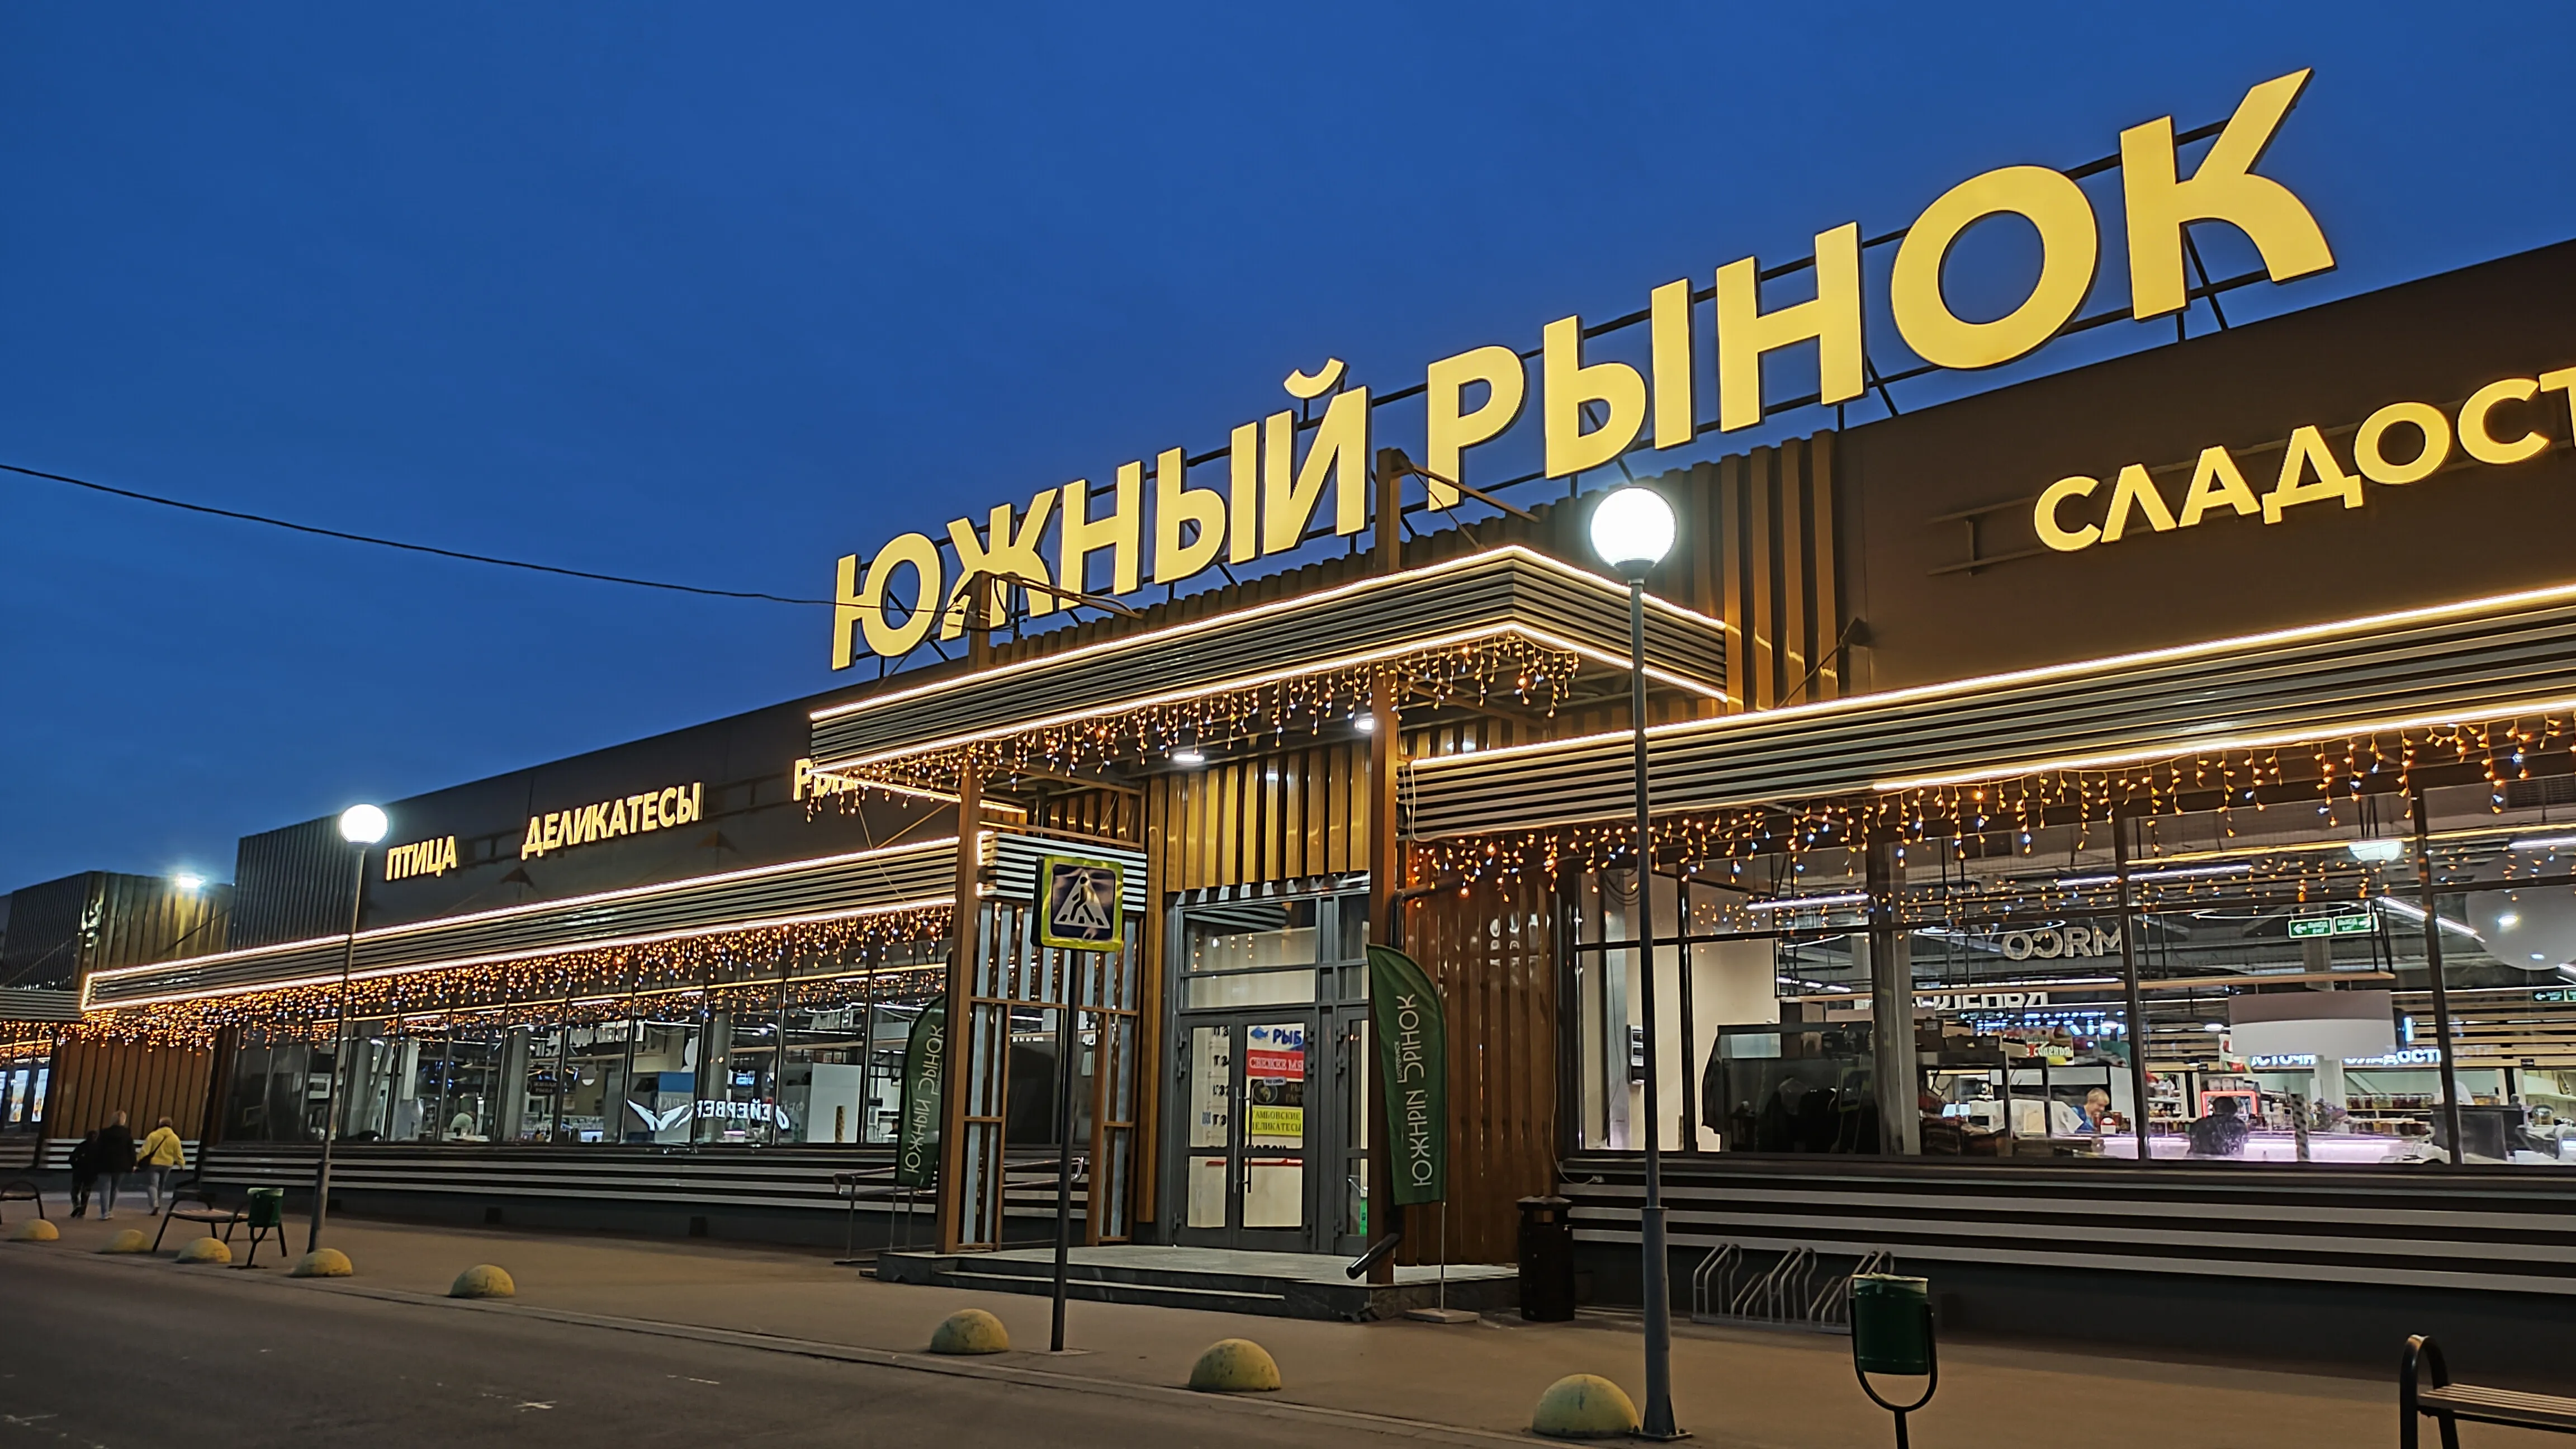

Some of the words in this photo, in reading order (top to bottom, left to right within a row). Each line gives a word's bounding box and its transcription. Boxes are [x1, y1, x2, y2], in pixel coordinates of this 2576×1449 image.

[831, 358, 1367, 671] ЮЖНЫЙ
[1427, 67, 2335, 514] РЫНОК
[386, 835, 457, 881] ПТИЦА
[521, 782, 702, 860] ДЕЛИКАТЕСЫ
[1272, 1028, 1303, 1045] РЫБ
[904, 1099, 932, 1173] ЮЖНЫЙ
